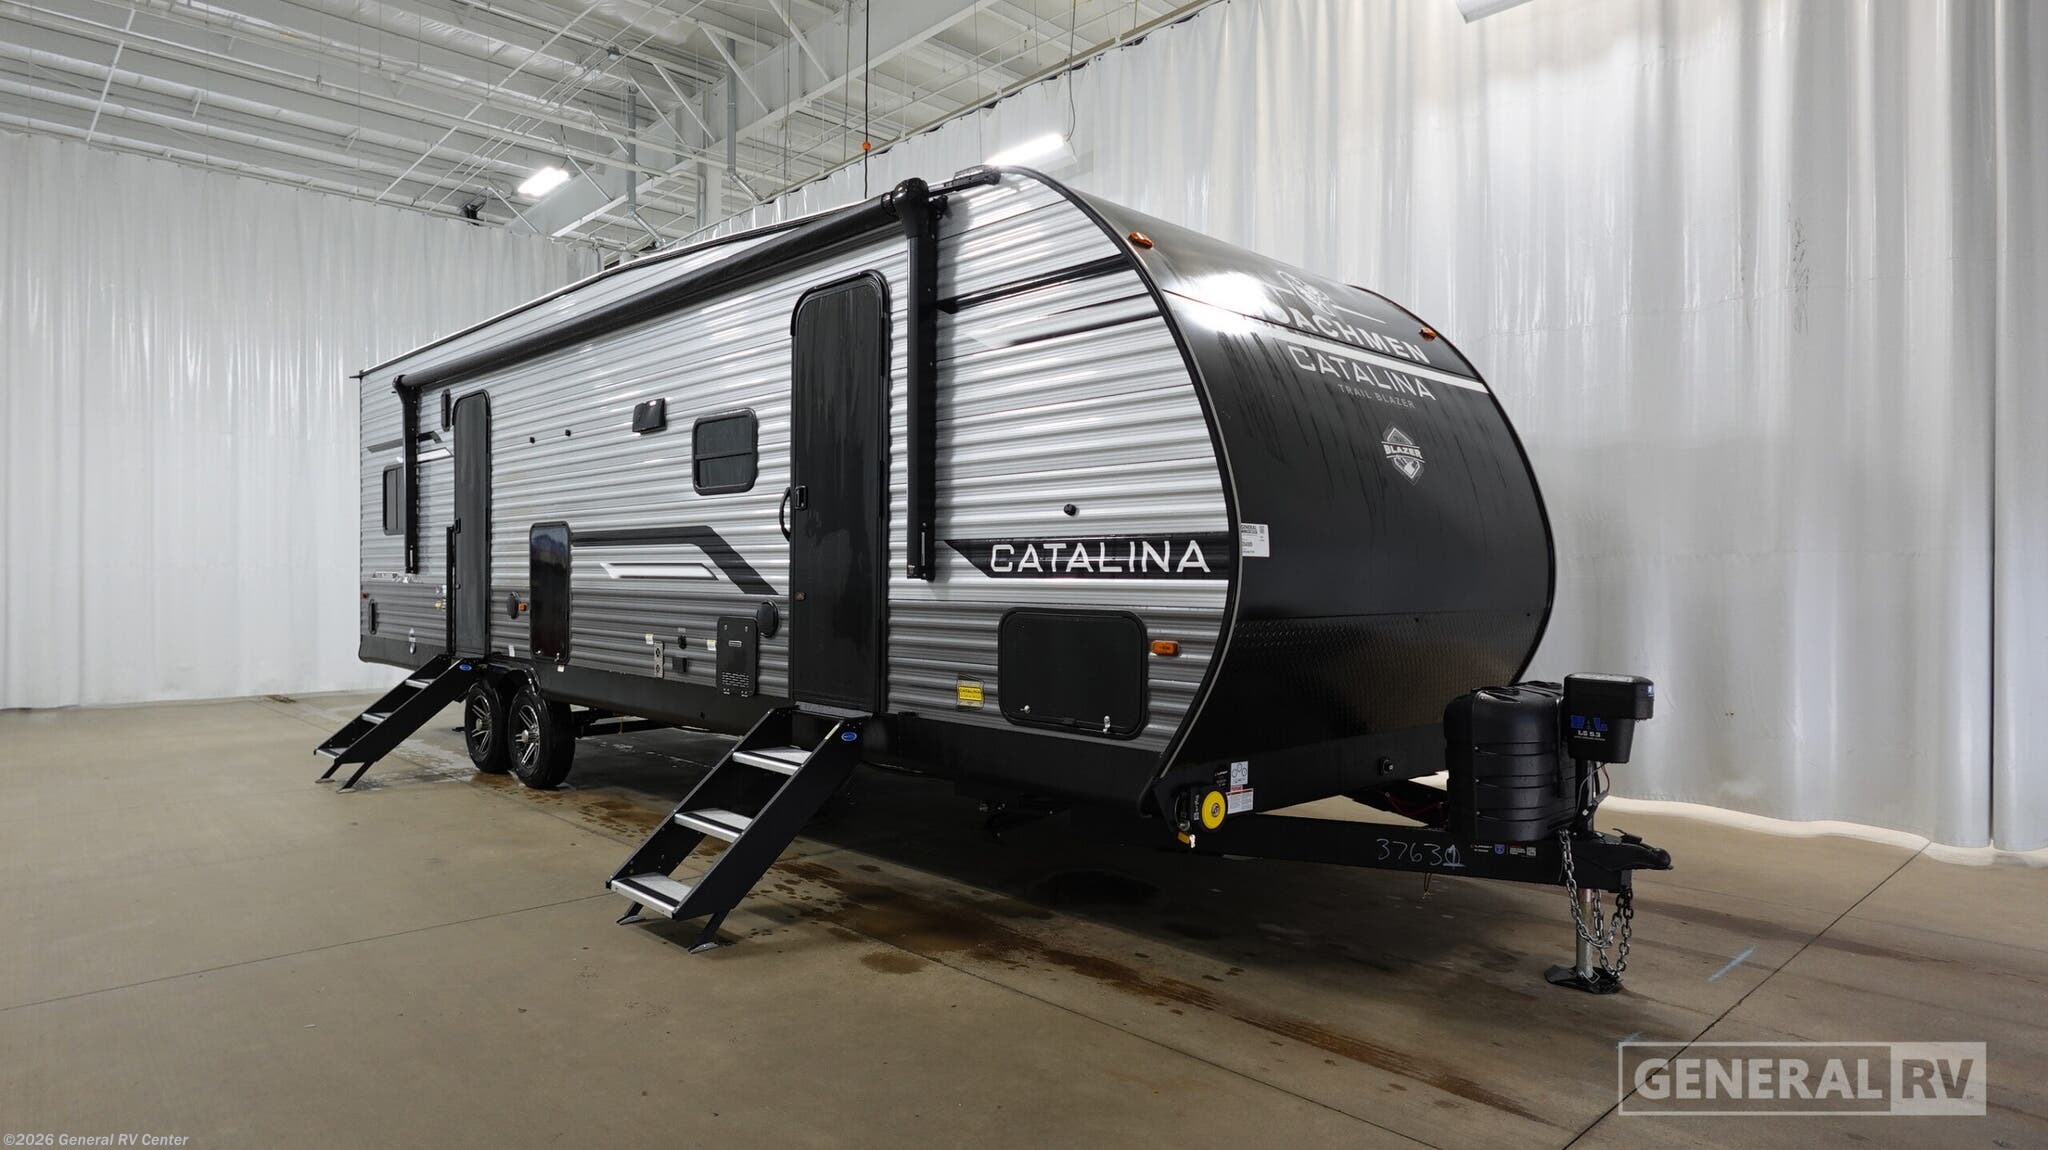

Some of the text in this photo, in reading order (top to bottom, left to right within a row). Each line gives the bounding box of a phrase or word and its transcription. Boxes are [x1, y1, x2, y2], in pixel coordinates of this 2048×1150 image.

[1262, 304, 1430, 364] OACHMEN
[1288, 345, 1436, 401] CATALINA
[1338, 384, 1416, 409] TRAIL BLAZER
[1383, 444, 1423, 459] BLAZER
[990, 540, 1211, 573] CATALINA
